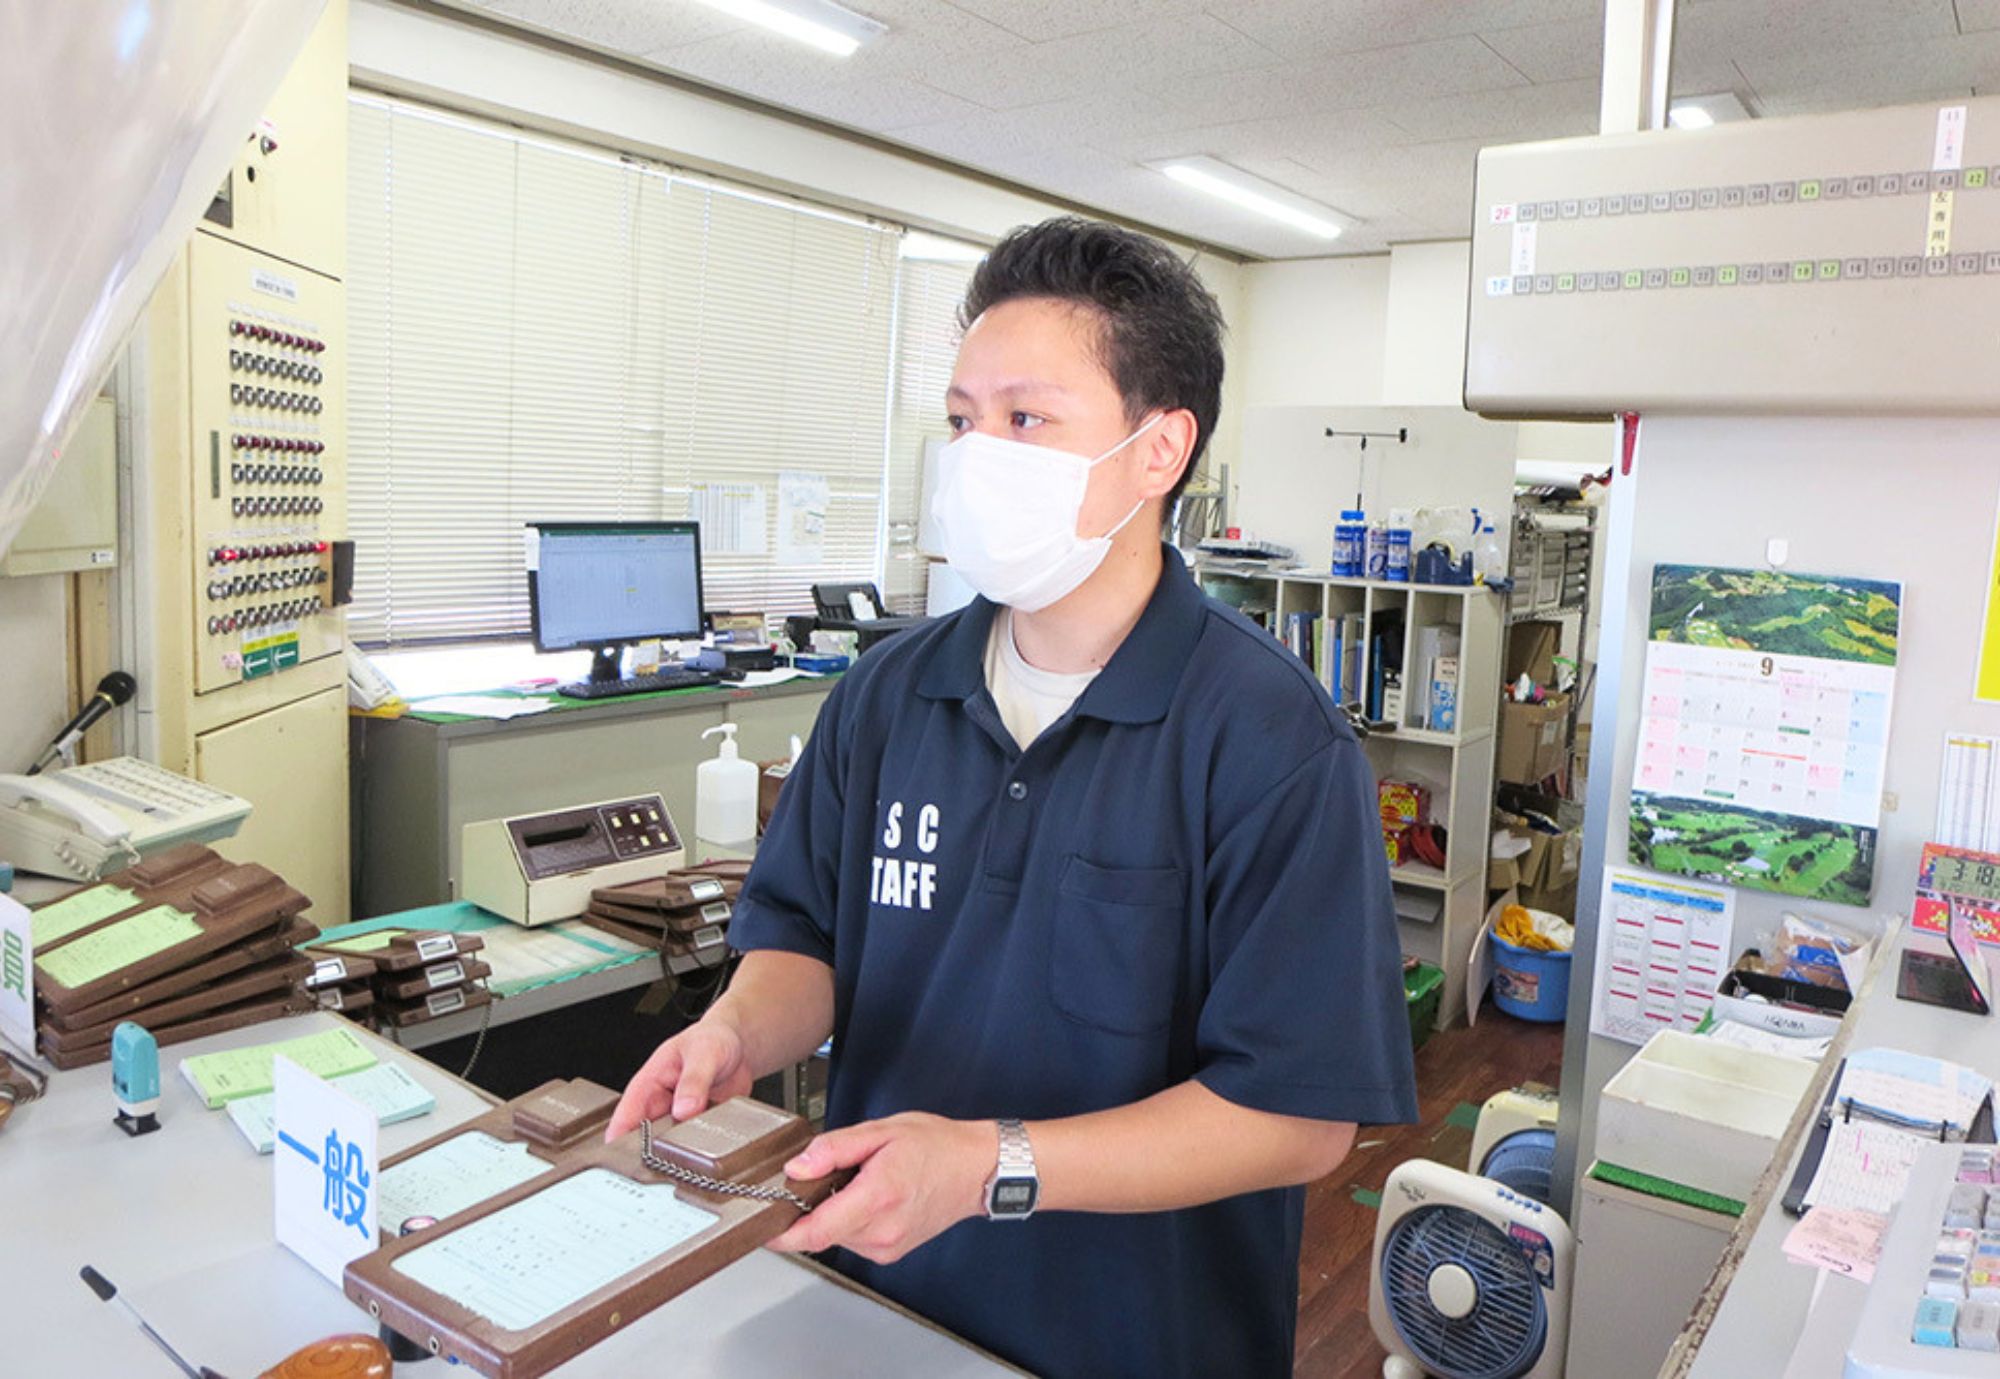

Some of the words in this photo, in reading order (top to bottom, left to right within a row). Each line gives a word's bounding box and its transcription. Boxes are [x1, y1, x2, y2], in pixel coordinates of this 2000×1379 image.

[1495, 207, 1510, 220] 2F
[1493, 279, 1509, 292] 1F
[1761, 657, 1773, 676] 9
[871, 856, 937, 910] TAFF
[279, 1128, 370, 1240] 一般
